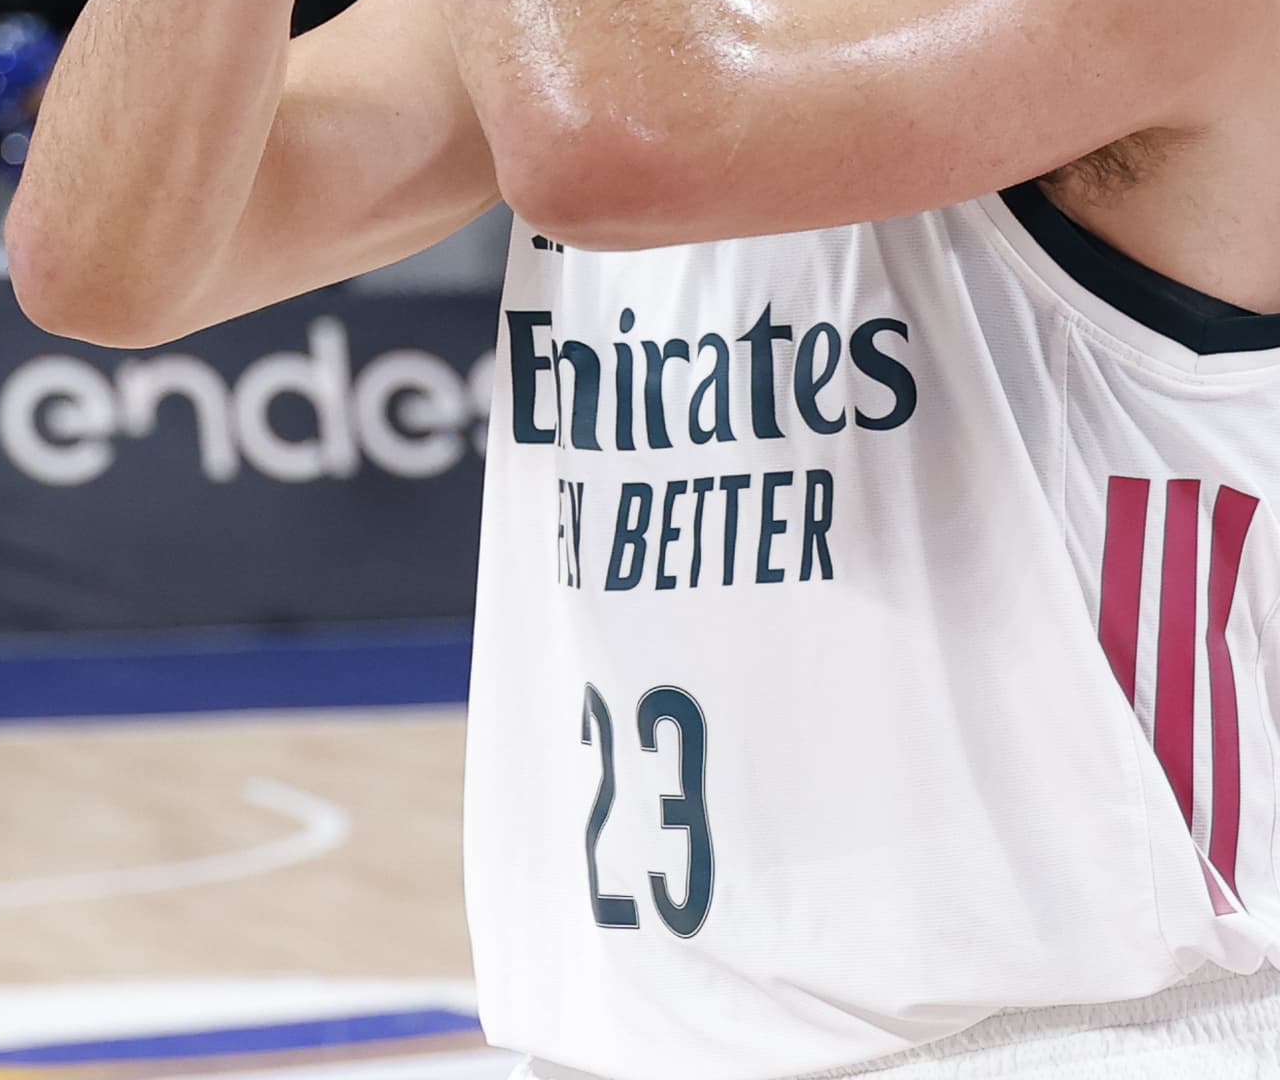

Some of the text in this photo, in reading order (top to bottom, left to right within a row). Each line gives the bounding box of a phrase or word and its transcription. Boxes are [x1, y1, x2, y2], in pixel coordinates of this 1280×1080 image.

[505, 301, 918, 451] Emirates
[604, 469, 834, 591] BETTER
[581, 681, 716, 939] 23
